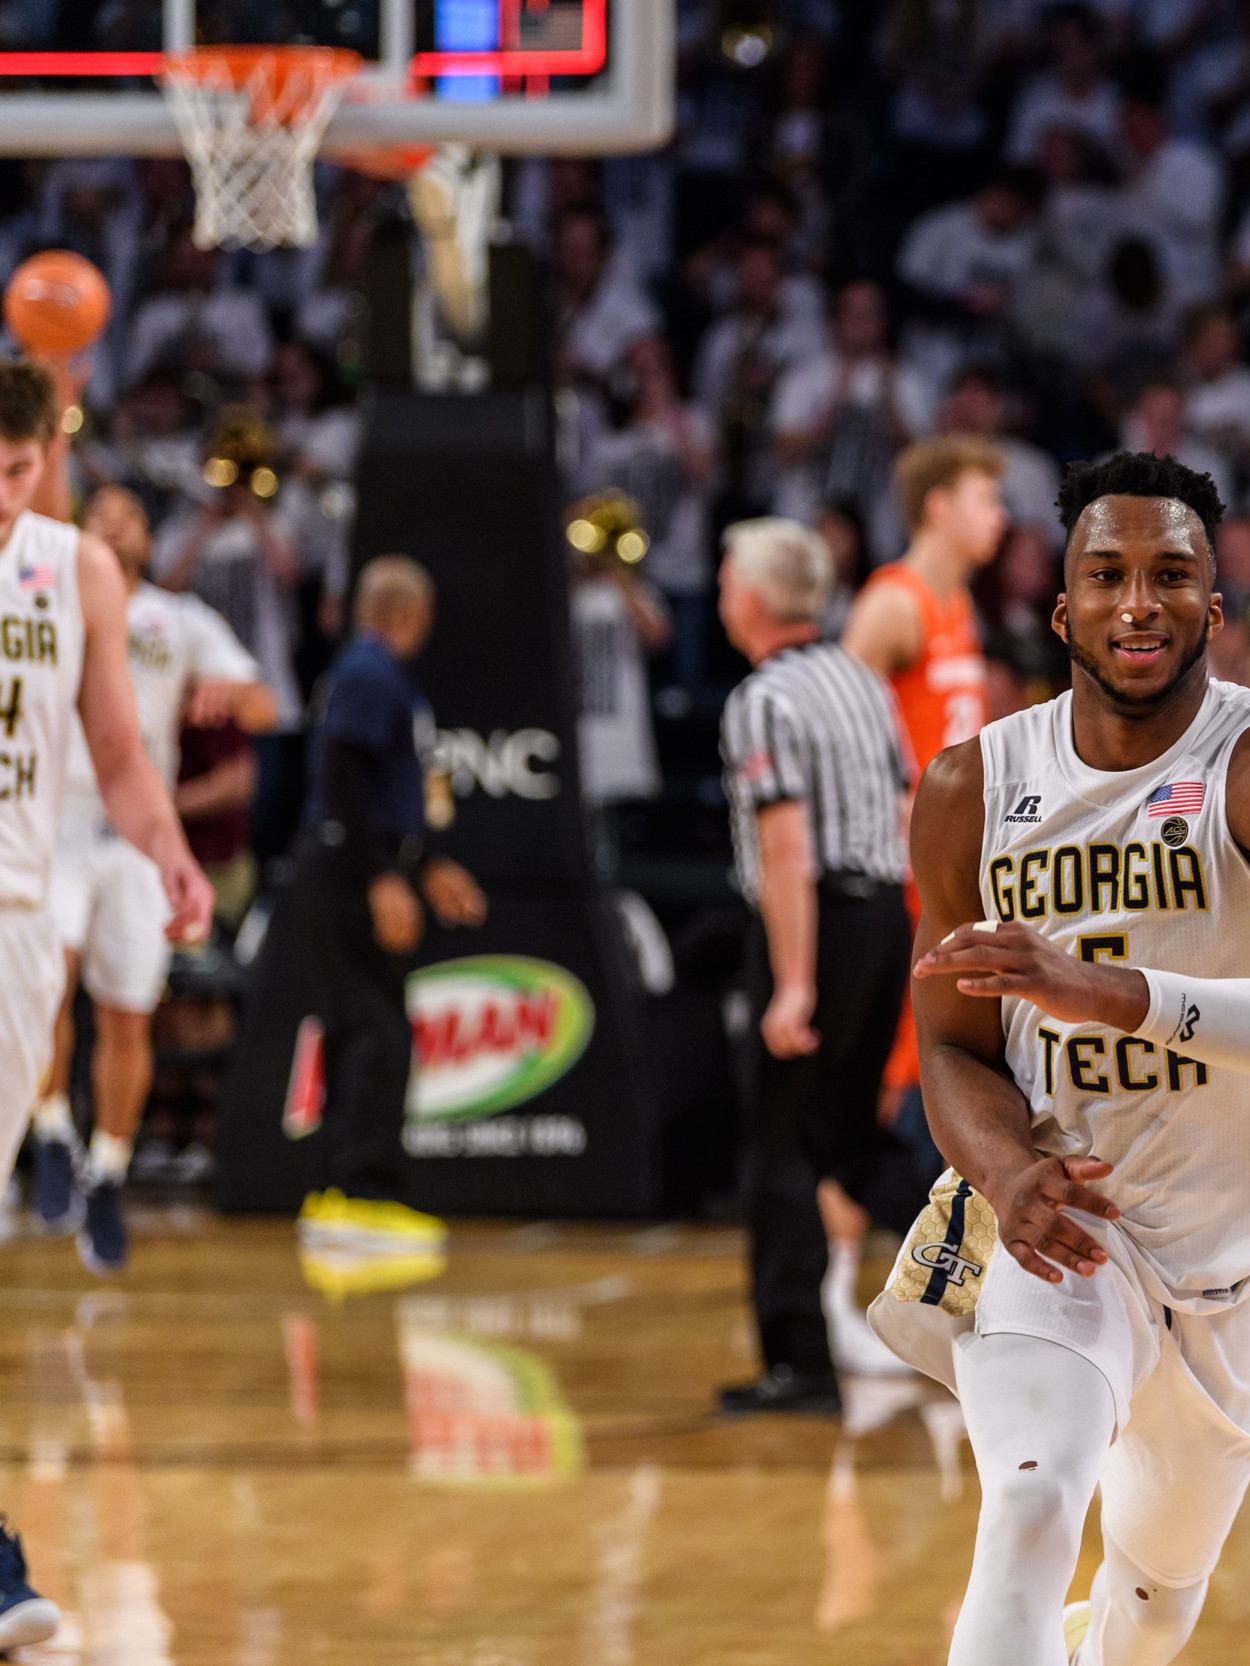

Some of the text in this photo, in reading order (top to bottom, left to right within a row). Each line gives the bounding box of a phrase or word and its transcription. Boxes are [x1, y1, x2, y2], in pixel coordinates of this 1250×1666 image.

[1004, 815, 1042, 823] RUSSELL
[988, 841, 1209, 923] GEORGIA
[1038, 1026, 1209, 1097] TECH
[911, 1241, 982, 1287] GT
